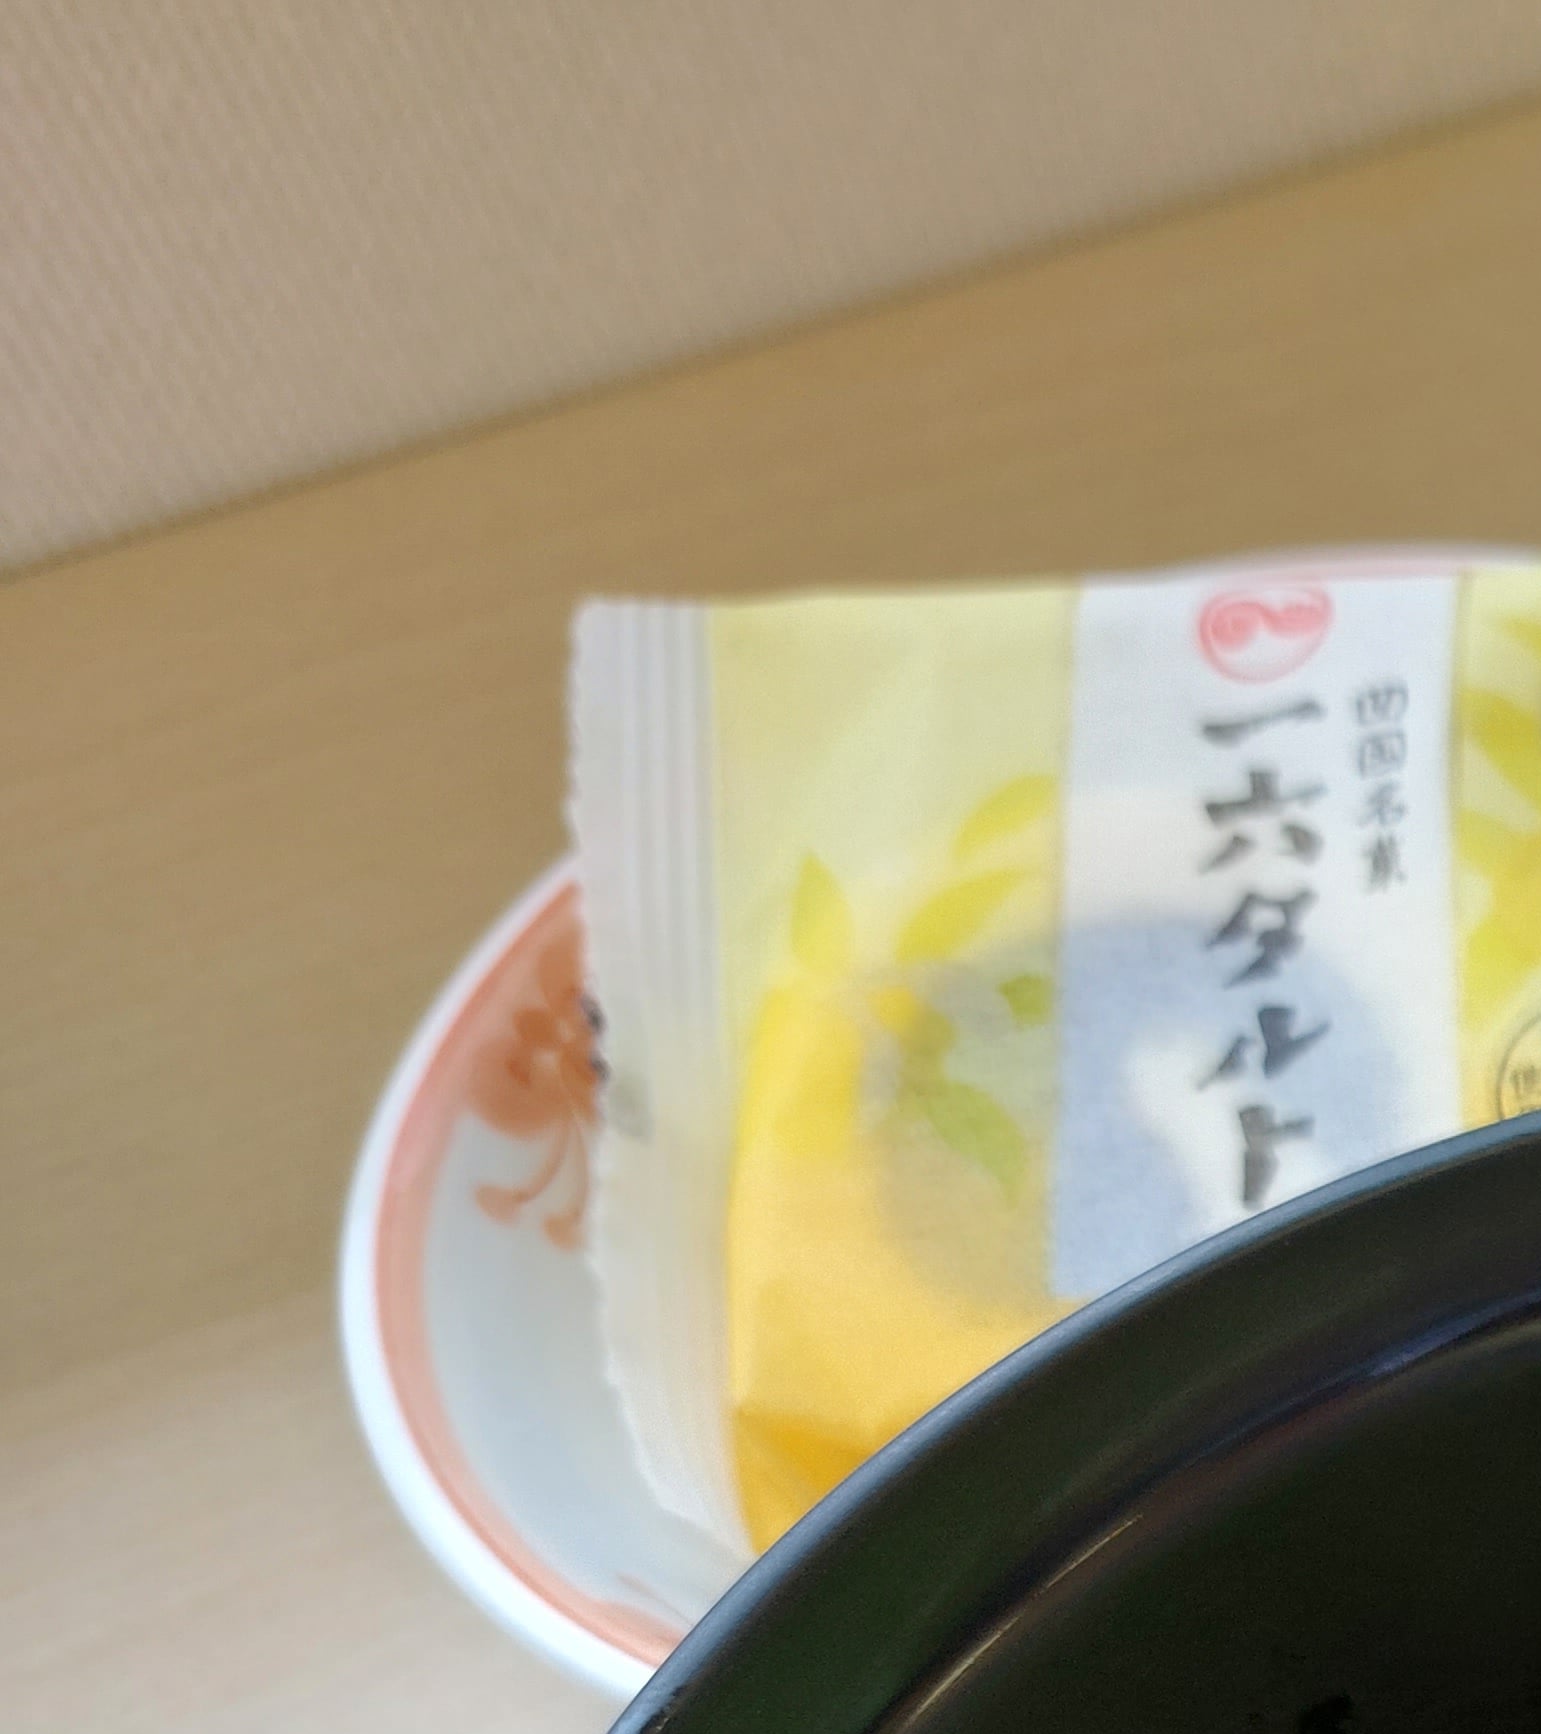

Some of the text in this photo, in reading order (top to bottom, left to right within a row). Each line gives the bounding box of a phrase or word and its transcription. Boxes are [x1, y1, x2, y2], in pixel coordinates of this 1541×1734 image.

[1198, 700, 1331, 1208] 一六タルト
